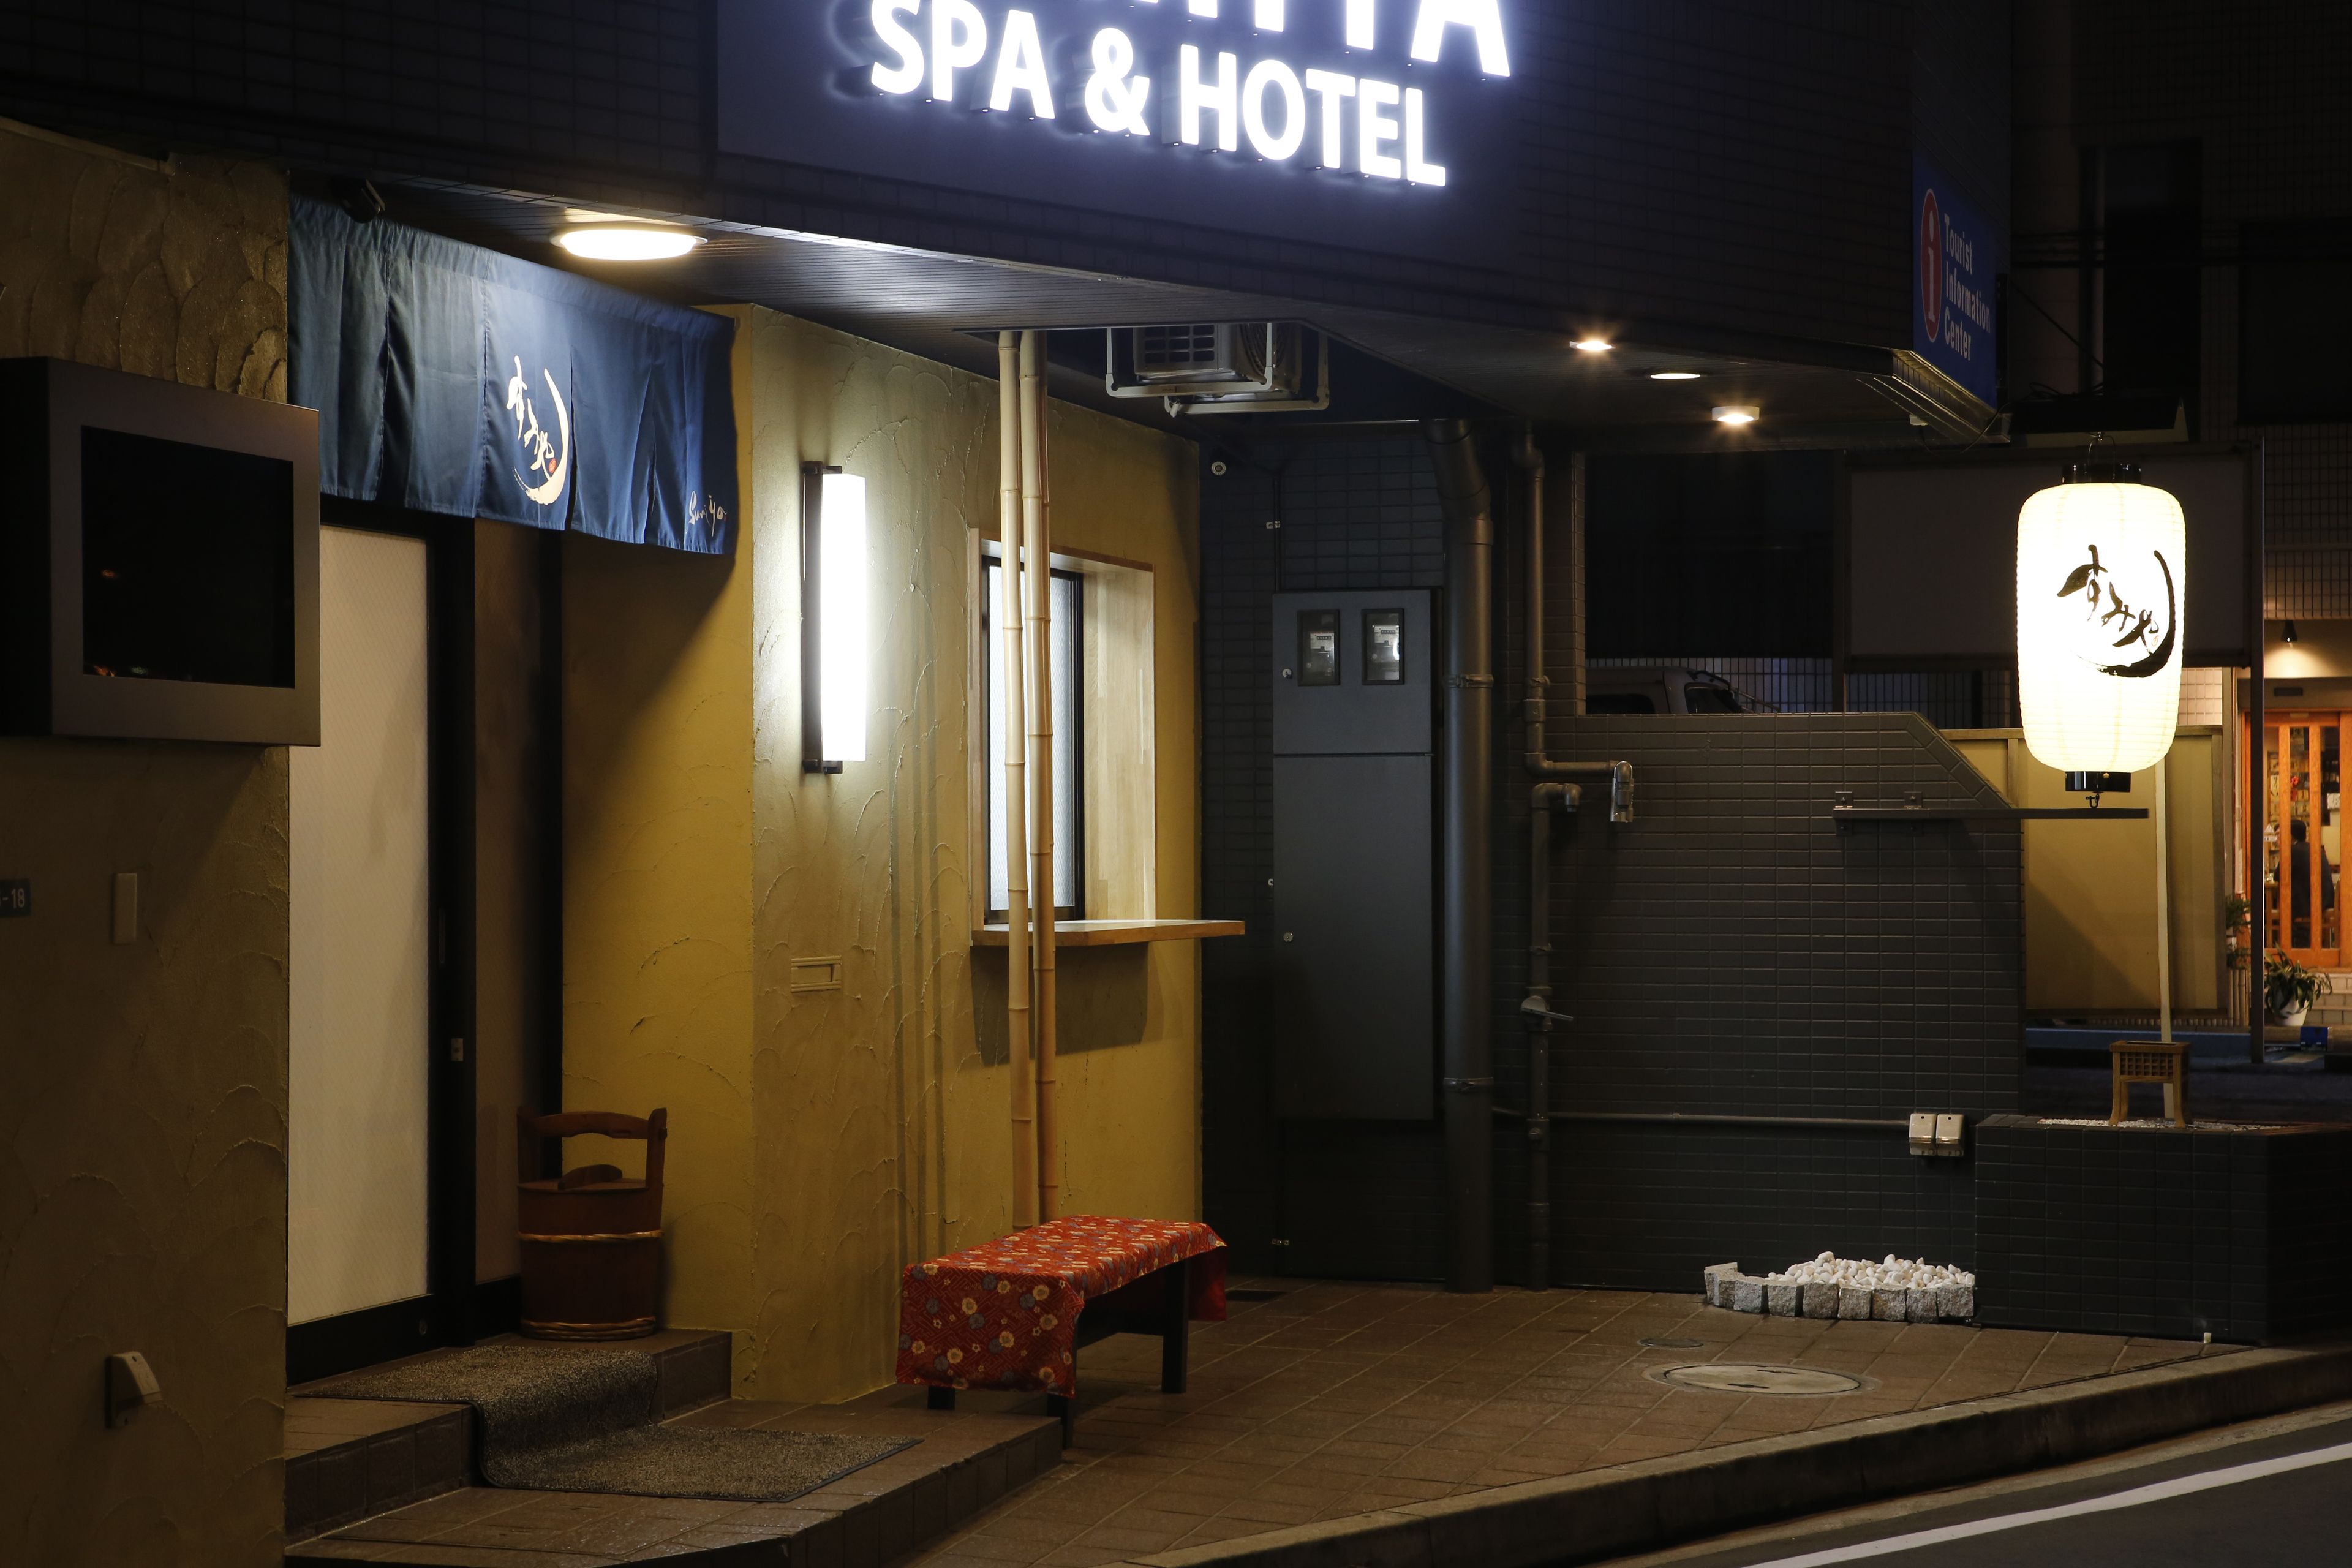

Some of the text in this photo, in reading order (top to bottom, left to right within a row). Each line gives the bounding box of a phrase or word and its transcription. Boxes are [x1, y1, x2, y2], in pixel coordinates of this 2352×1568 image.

[871, 0, 1055, 119] SPA
[1084, 27, 1150, 135] &
[1180, 43, 1446, 186] HOTEL
[1944, 213, 1973, 275] Tourist
[1945, 260, 1991, 334] Information
[1944, 306, 1972, 361] Center
[0, 888, 25, 909] -18
